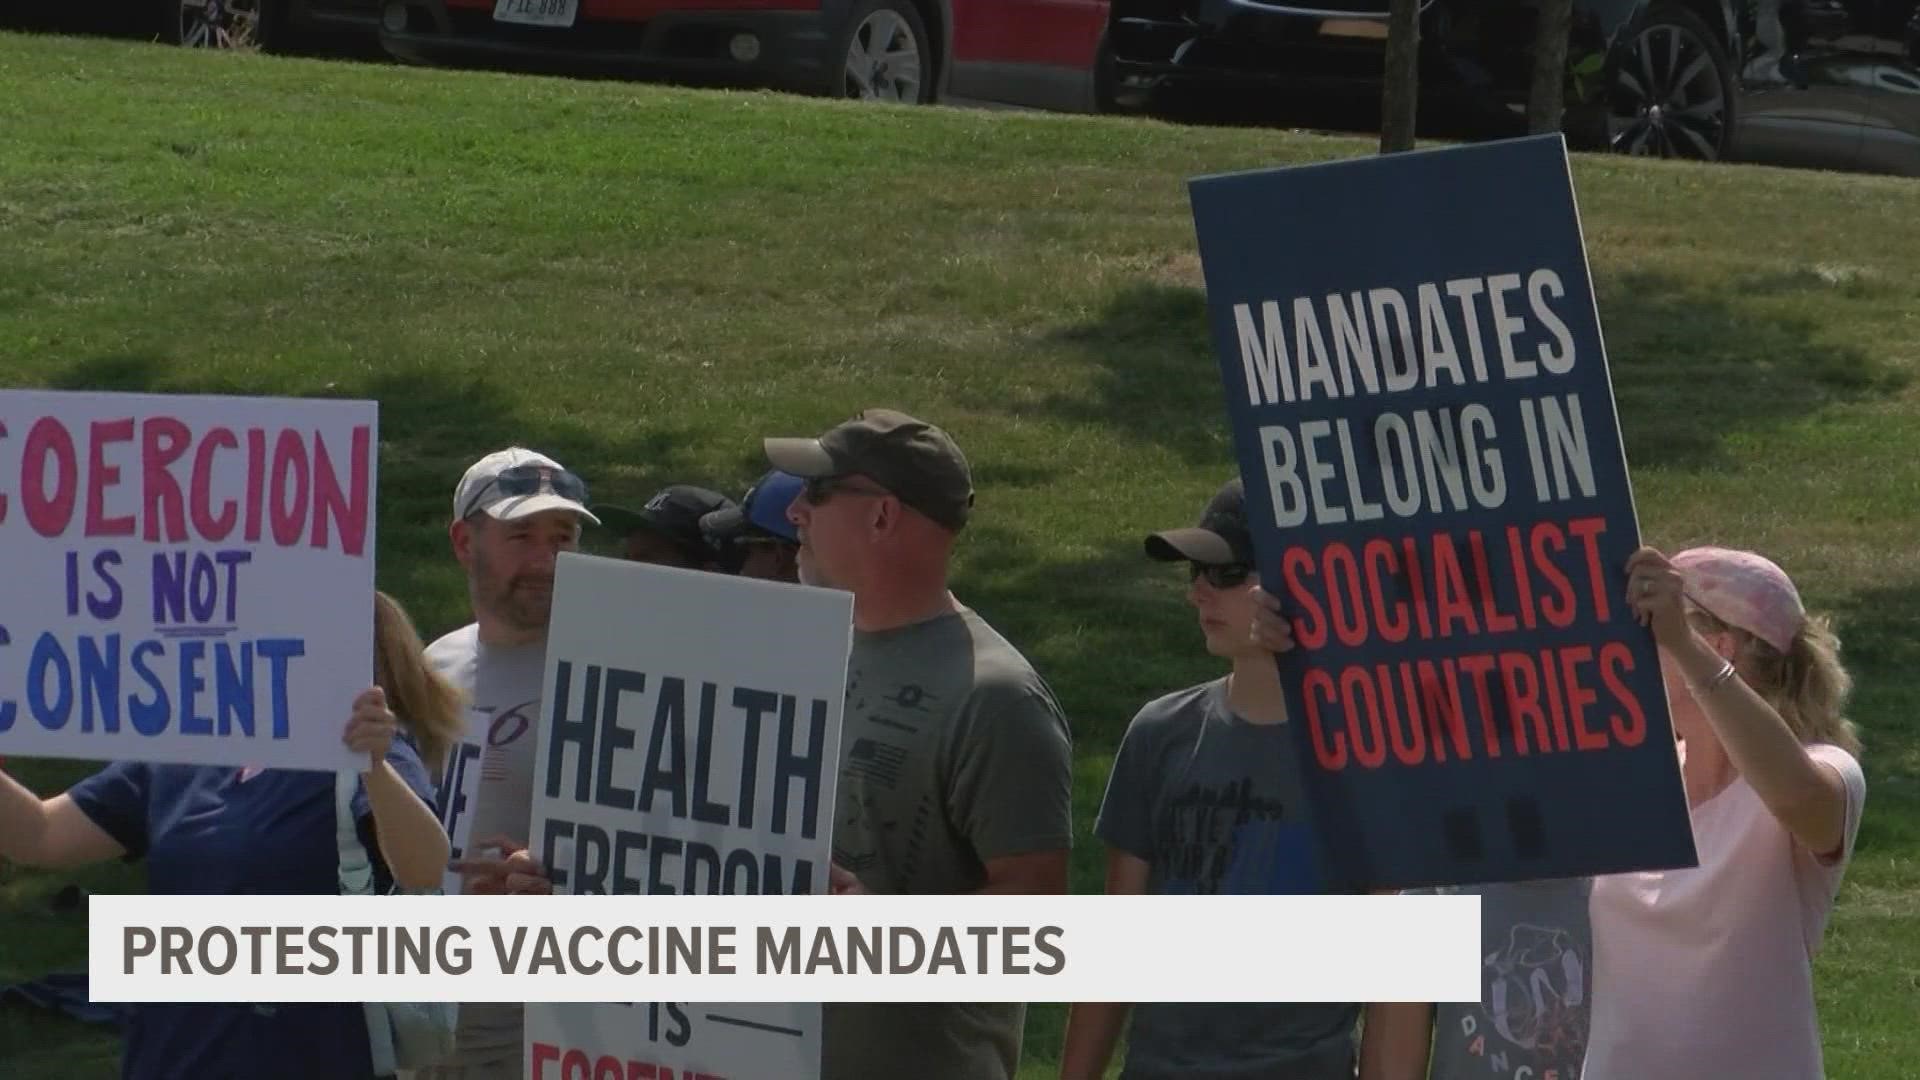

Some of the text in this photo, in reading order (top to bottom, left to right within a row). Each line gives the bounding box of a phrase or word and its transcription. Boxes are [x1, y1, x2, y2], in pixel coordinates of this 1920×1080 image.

[1233, 268, 1576, 407] MANDATES
[1259, 392, 1597, 528] BELONG IN
[66, 549, 251, 625] IS NOT
[1283, 516, 1610, 652] SOCIALIST
[545, 658, 828, 839] HEALTH
[1303, 640, 1648, 771] COUNTRIES
[648, 1002, 692, 1047] IS
